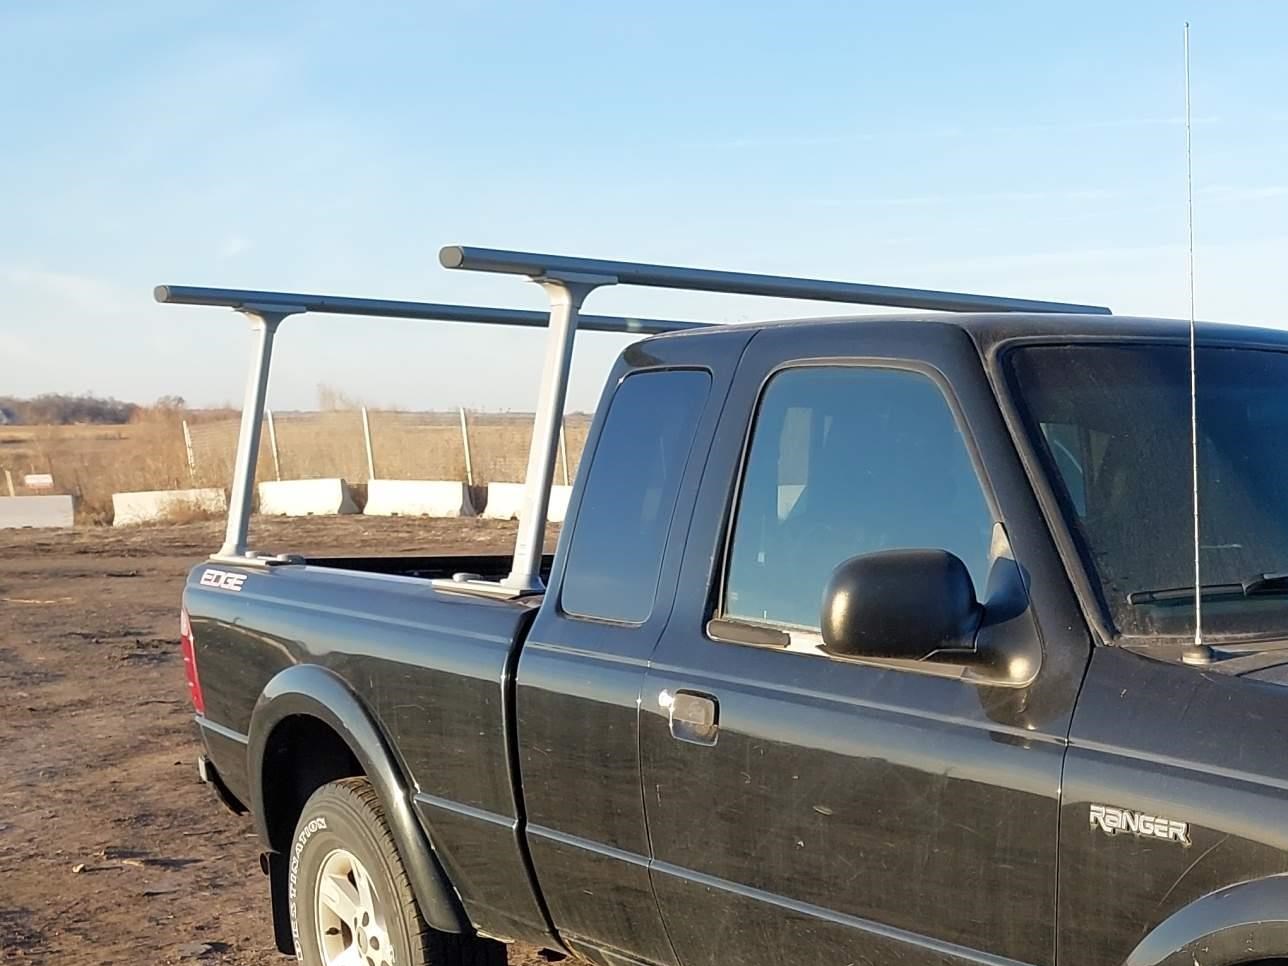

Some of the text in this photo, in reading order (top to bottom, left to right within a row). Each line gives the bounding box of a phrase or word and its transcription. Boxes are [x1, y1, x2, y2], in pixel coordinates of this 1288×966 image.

[200, 568, 248, 592] EDGE
[1090, 803, 1190, 845] RANGER
[288, 816, 328, 961] DESTINATION
